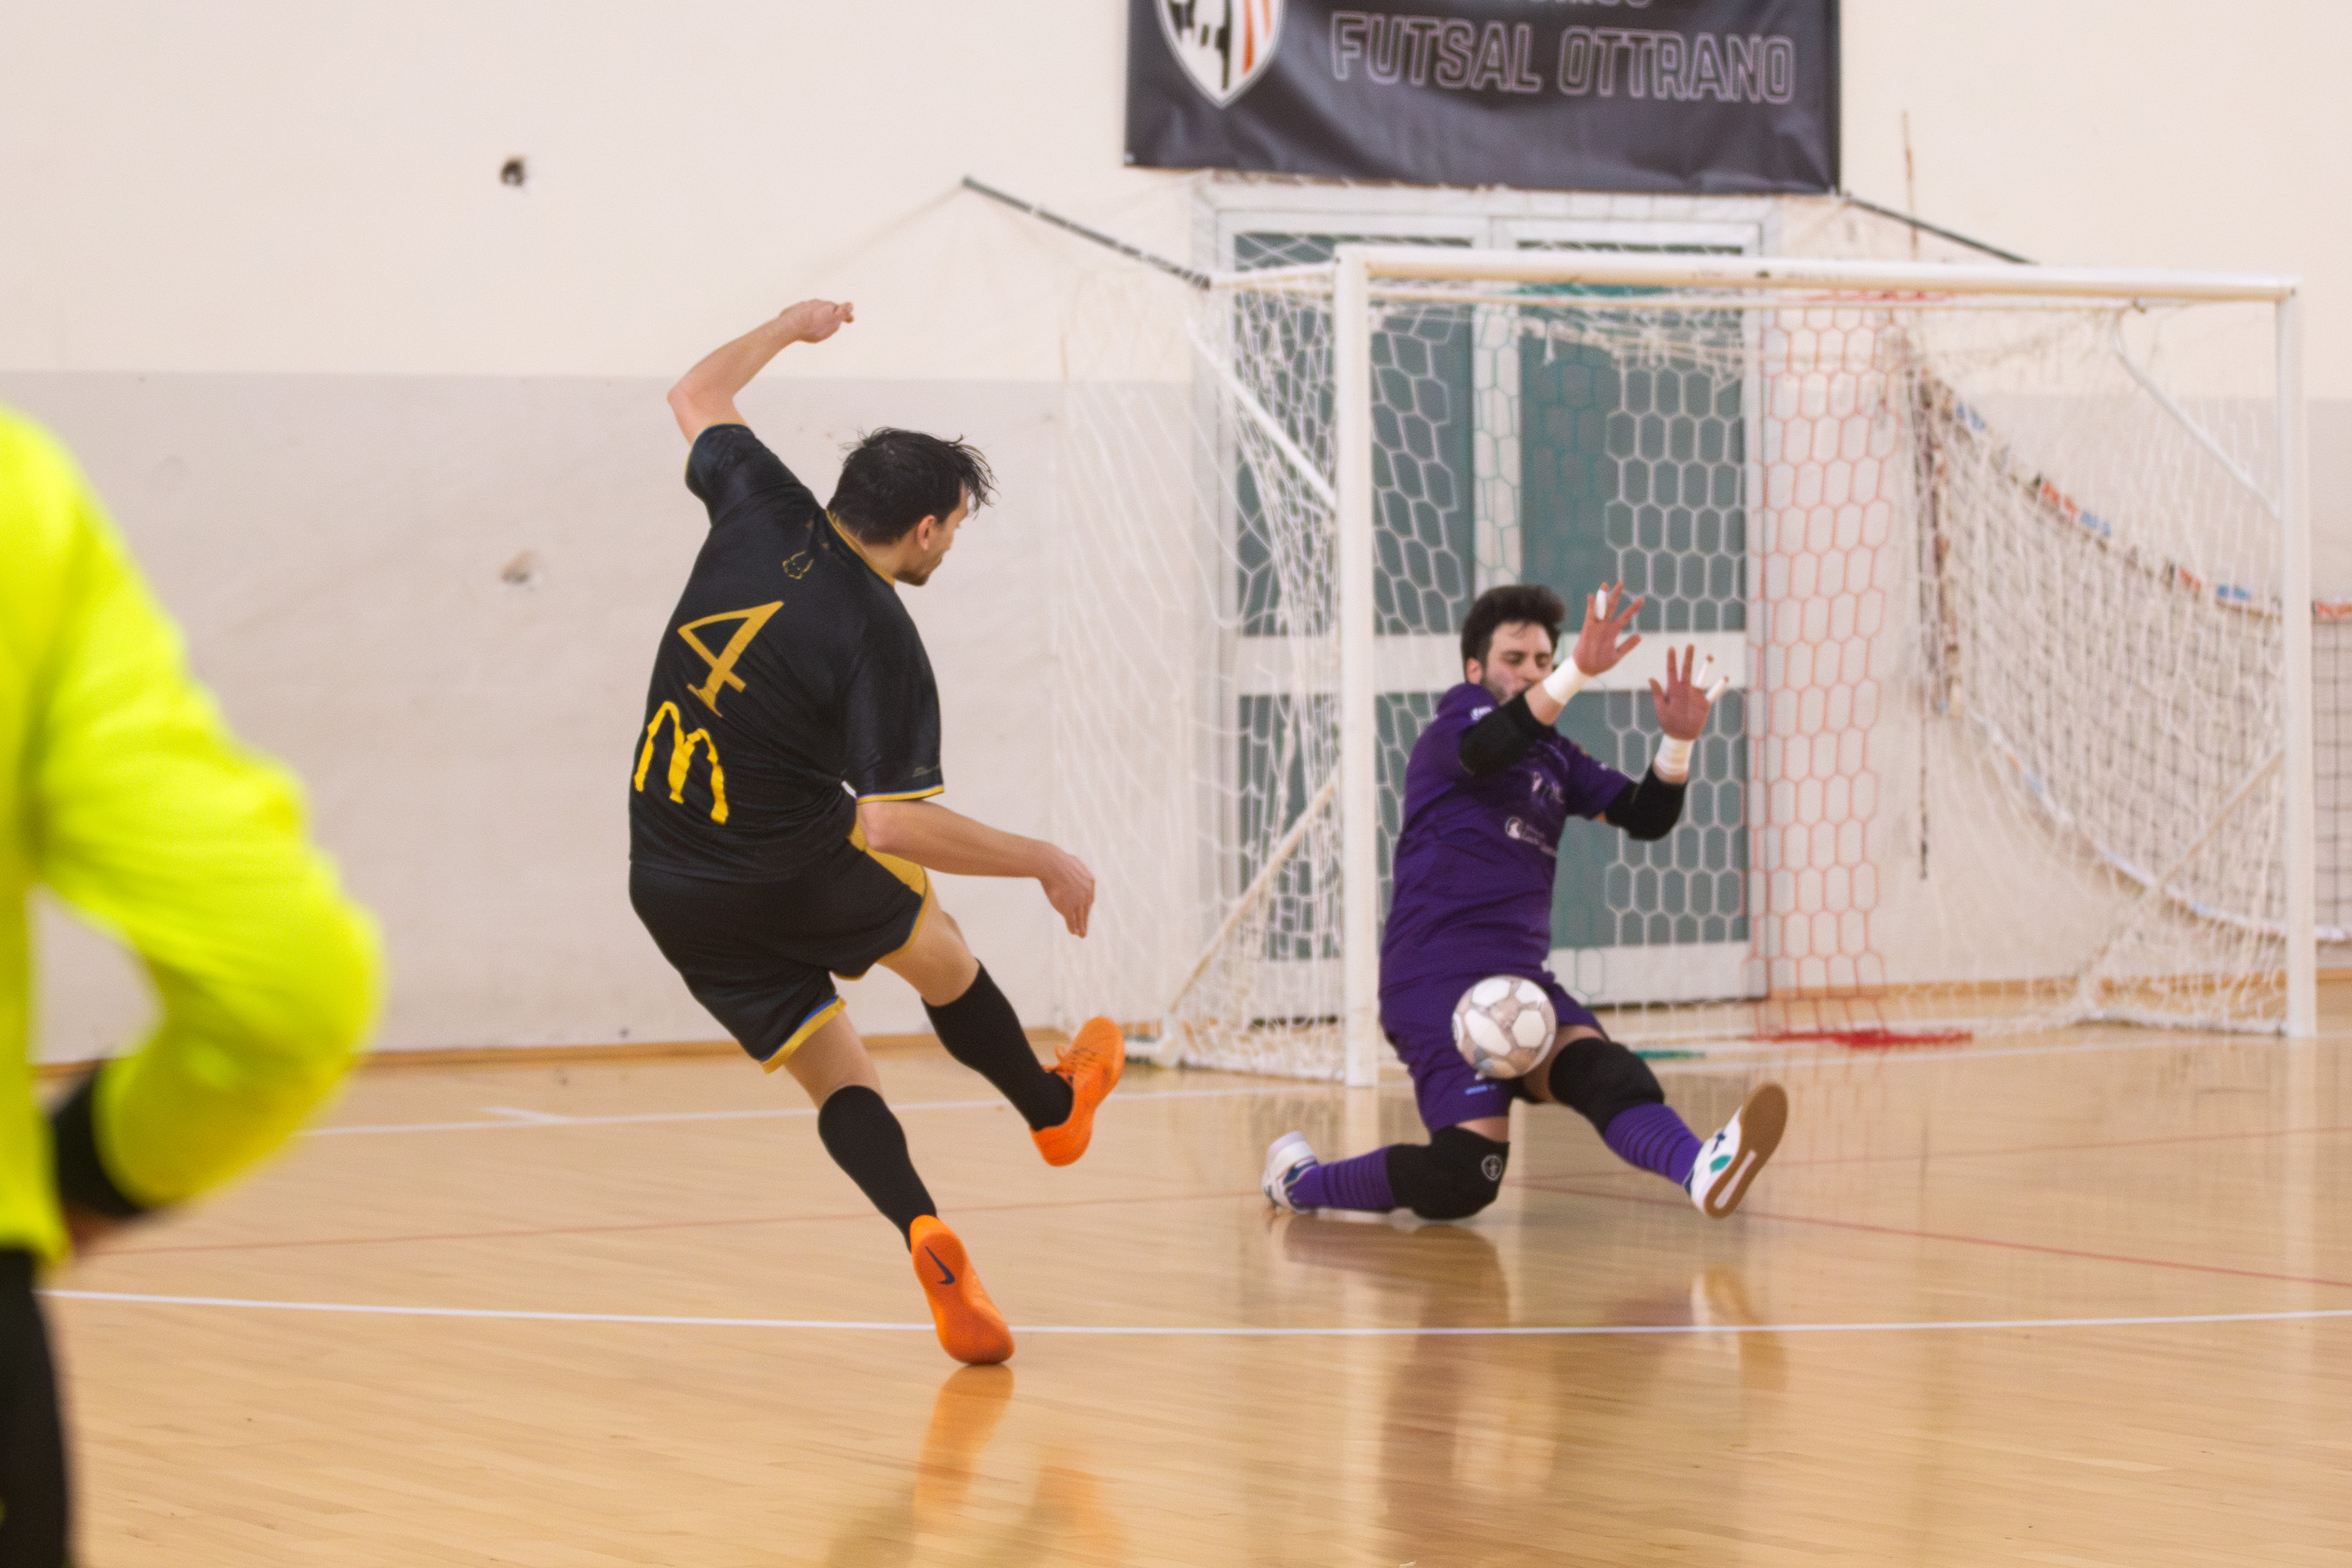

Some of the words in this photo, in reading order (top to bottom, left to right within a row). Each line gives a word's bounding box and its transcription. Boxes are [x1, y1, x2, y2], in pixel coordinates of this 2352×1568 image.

[1331, 10, 1543, 93] FUTSAL
[1558, 25, 1794, 105] OTTRANO
[677, 600, 784, 718] 4
